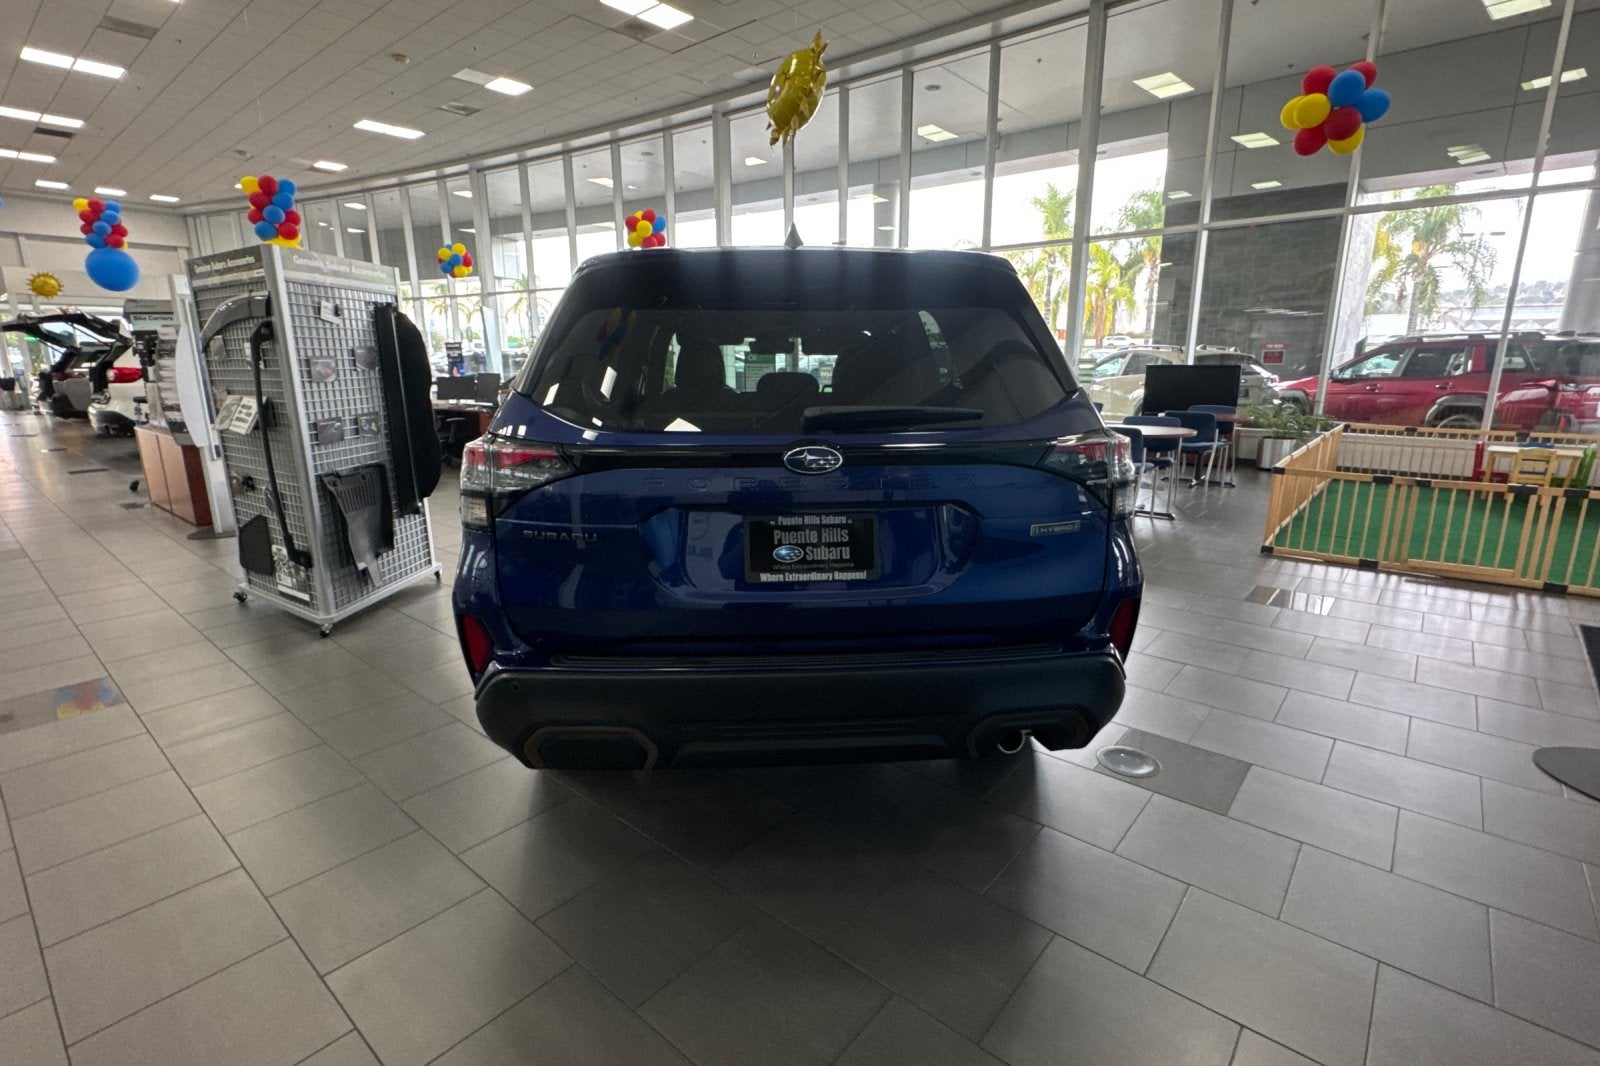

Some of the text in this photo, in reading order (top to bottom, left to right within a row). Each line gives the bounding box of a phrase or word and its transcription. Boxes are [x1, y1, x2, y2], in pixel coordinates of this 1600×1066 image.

[293, 255, 323, 267] Genuine
[643, 475, 977, 492] FORESTER
[778, 514, 847, 526] Puente Hills Subaru
[1040, 525, 1074, 533] HYBRID
[523, 530, 597, 541] SUBARU
[773, 527, 849, 545] Puente Hills
[805, 545, 851, 561] Subaru
[760, 570, 867, 582] Where Extraordinary Happens!
